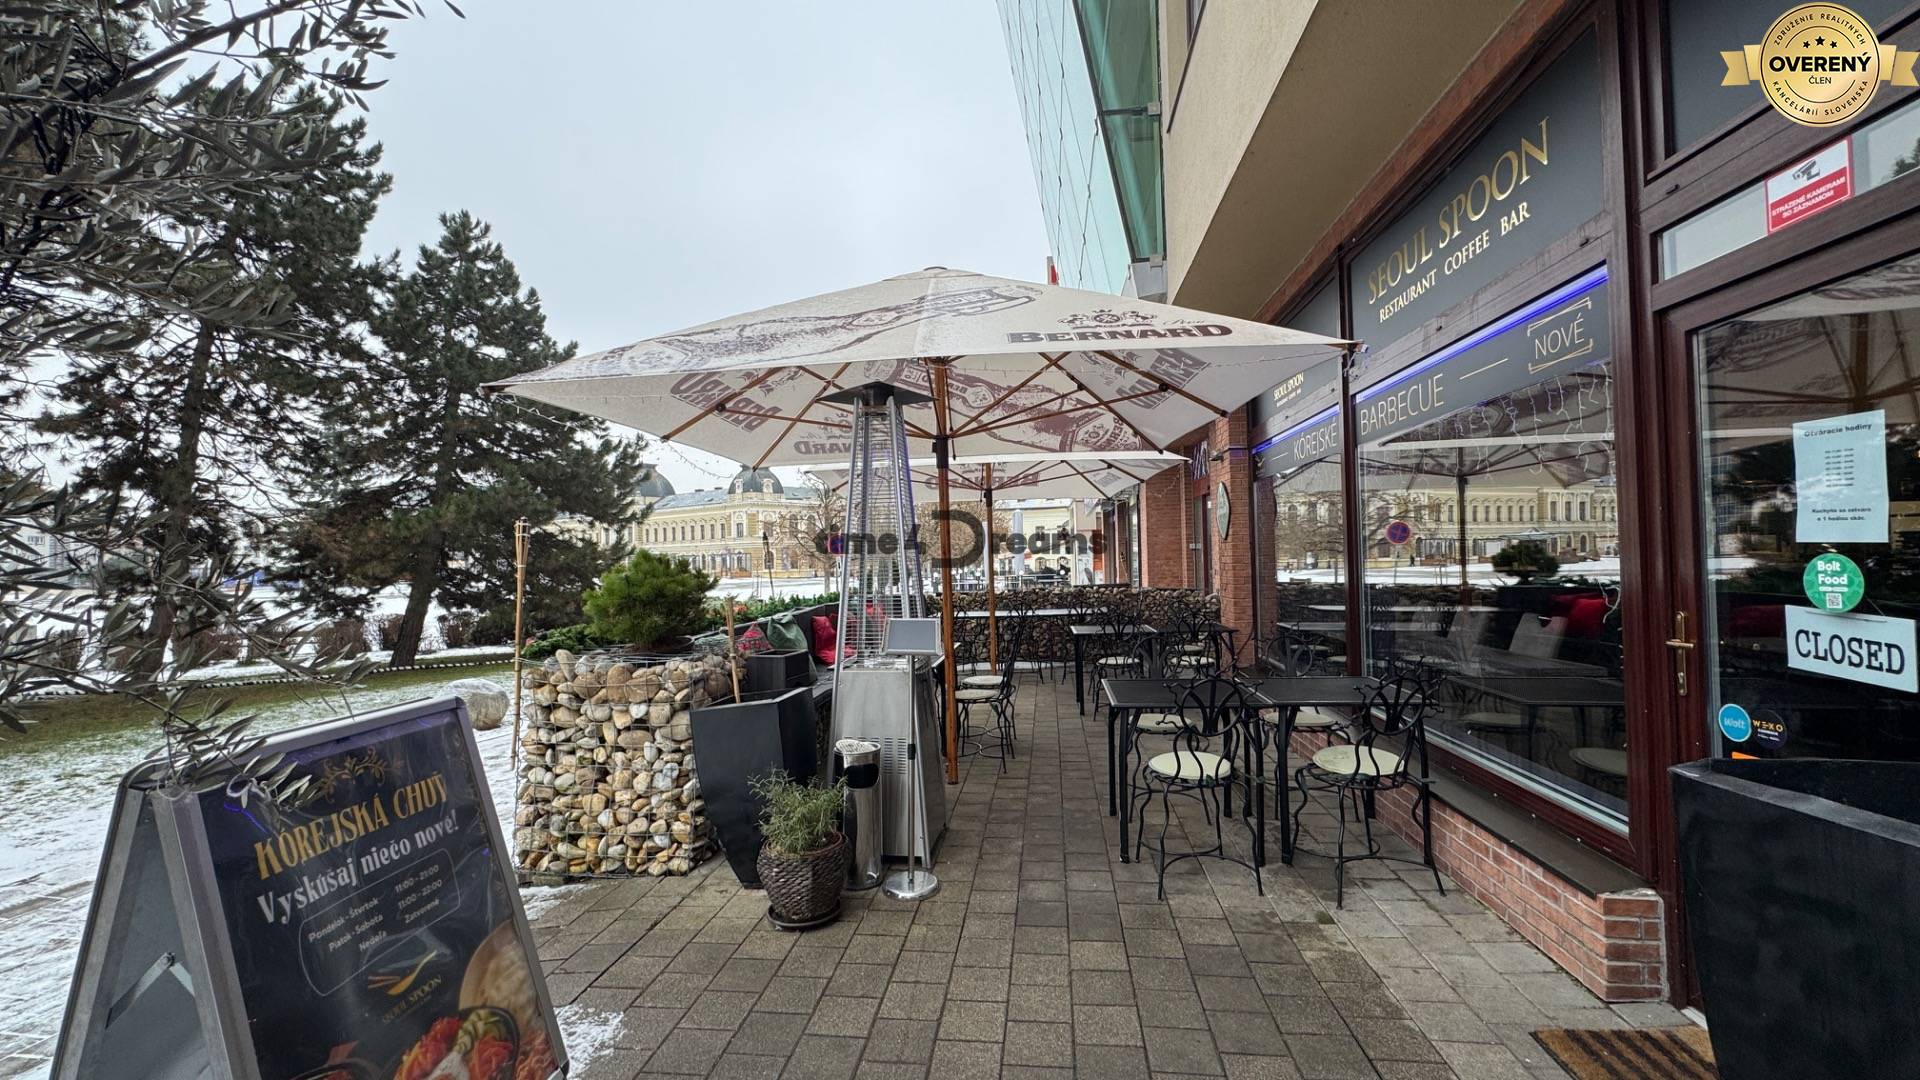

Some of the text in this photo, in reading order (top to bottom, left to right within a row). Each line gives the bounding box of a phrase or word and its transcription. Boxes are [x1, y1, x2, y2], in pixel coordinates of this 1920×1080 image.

[1368, 115, 1550, 305] SEOUL SPOON
[1379, 201, 1531, 324] RESTAURANT COFFEE BAR
[1007, 324, 1233, 344] BERNARD
[1533, 313, 1586, 359] NOVÉ
[1360, 373, 1445, 436] BARBECUE
[1845, 423, 1872, 432] hodiny
[1293, 419, 1338, 461] KÓREJSKÉ
[1817, 561, 1841, 571] Bolt
[1818, 574, 1848, 584] Food
[1795, 629, 1905, 675] CLOSED
[1724, 717, 1746, 729] Wolt
[254, 793, 390, 880] KÓREJSKÁ
[256, 809, 460, 925] Vyskúšaj niečo nové!
